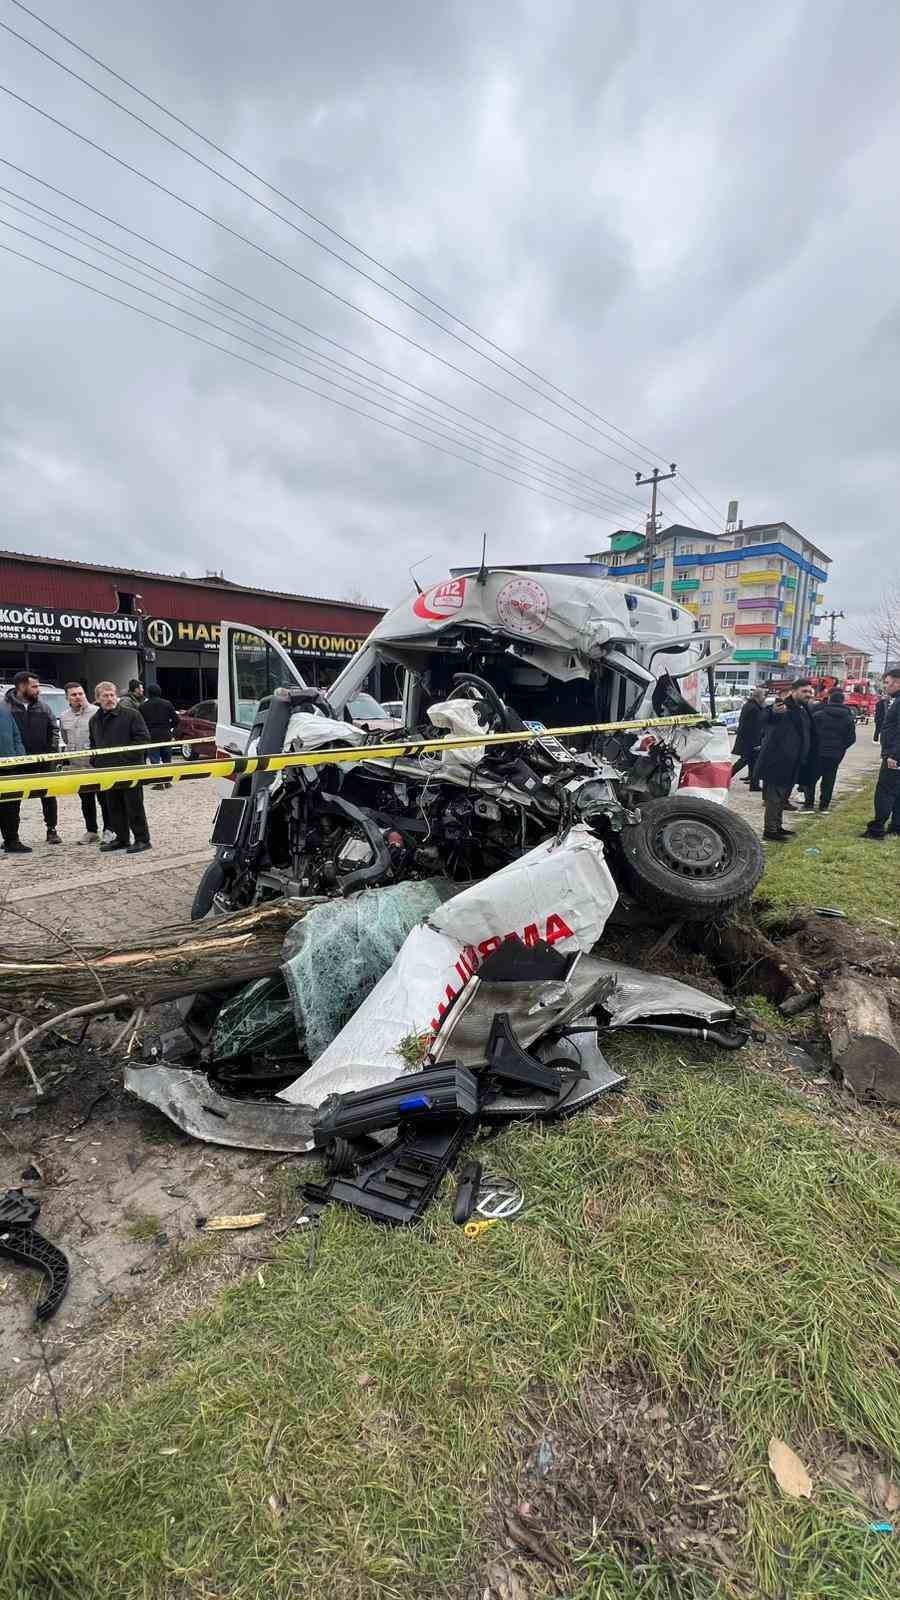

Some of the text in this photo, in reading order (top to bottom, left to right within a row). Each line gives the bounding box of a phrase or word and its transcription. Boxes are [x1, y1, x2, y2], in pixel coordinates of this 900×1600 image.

[440, 581, 460, 596] 112
[60, 614, 138, 633] OTOMOTİV
[97, 631, 132, 640] AKOĞLU
